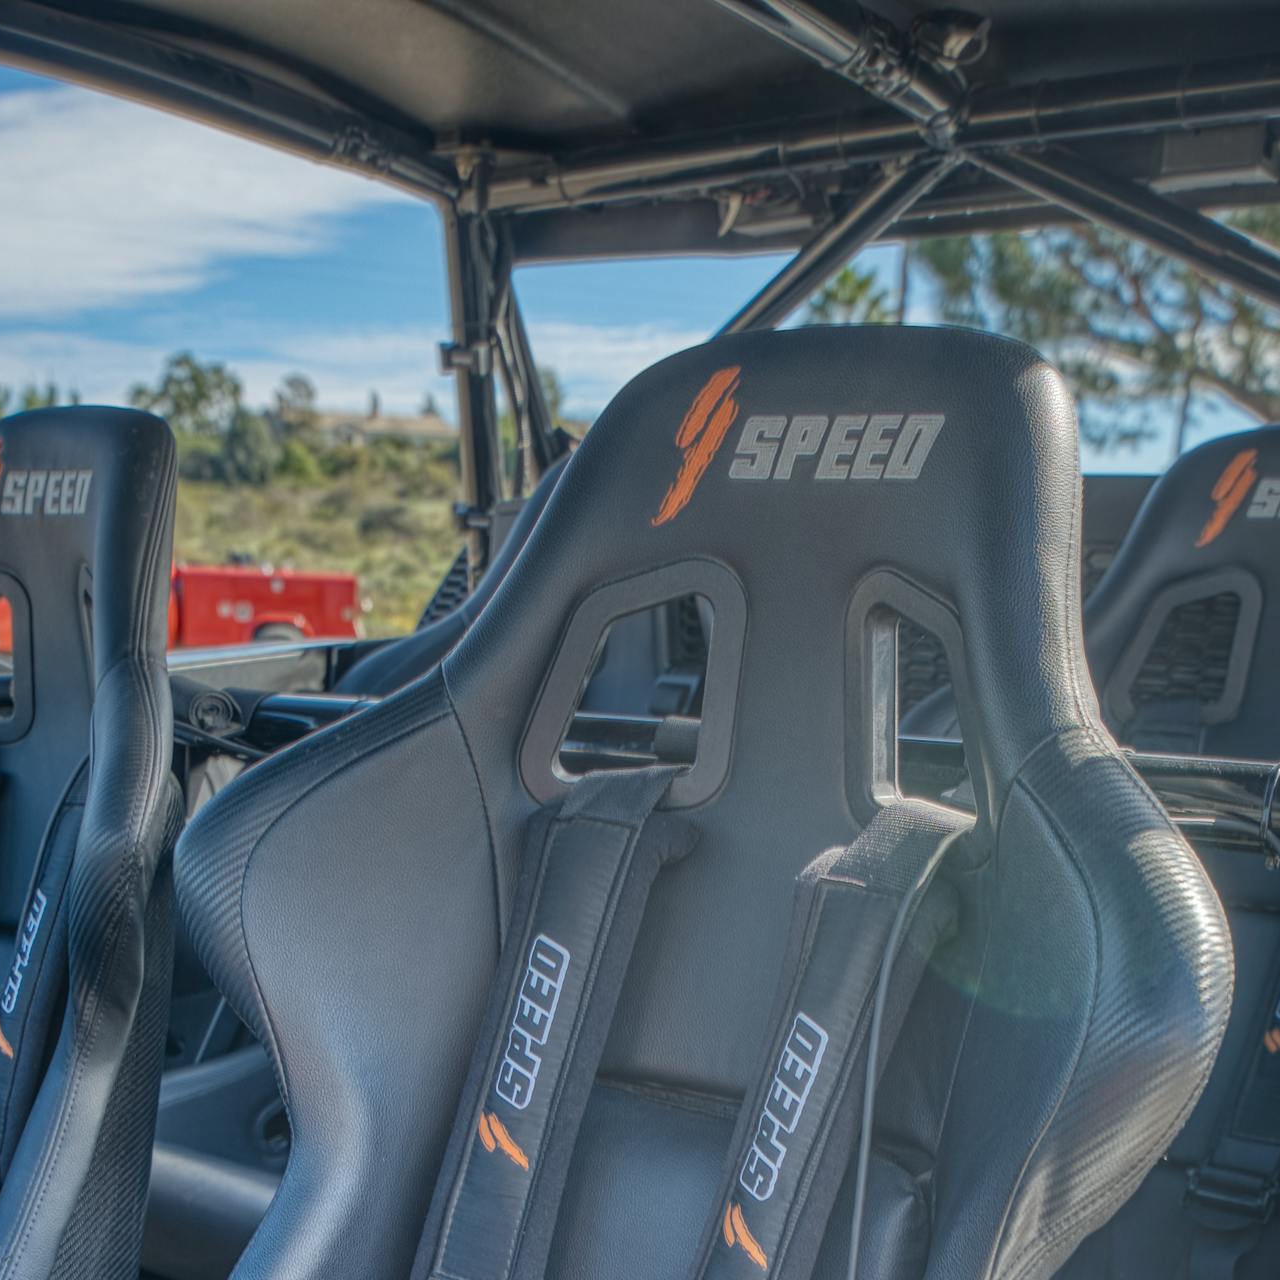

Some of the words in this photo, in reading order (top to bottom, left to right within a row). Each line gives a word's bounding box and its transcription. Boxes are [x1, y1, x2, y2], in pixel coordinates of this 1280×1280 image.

[0, 470, 93, 514] SPEED
[728, 414, 946, 480] SPEED
[495, 934, 570, 1109] SPEED
[740, 1011, 829, 1201] SPEED
